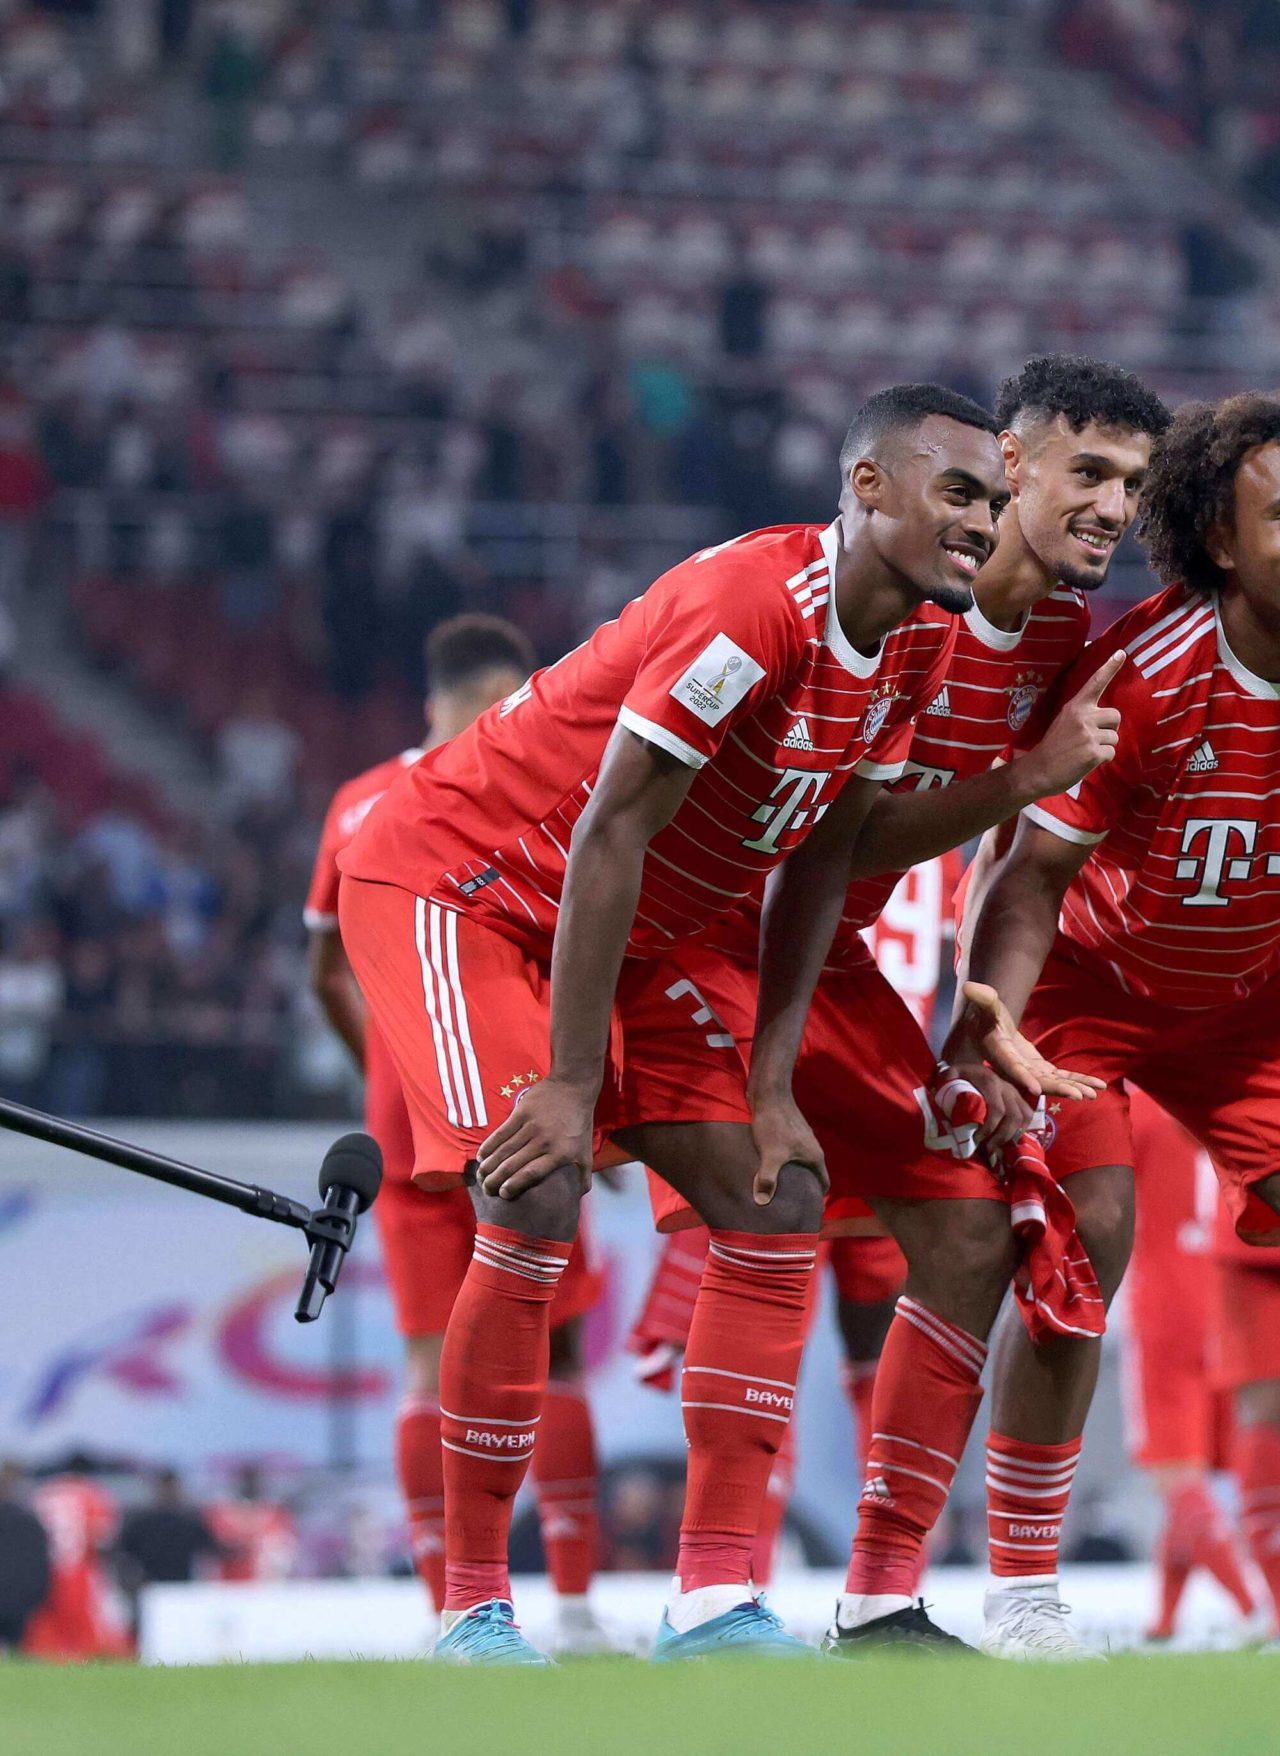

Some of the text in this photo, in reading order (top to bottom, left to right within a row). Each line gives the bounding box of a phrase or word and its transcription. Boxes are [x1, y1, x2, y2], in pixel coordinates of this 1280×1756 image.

[686, 682, 720, 710] SUPERCUP
[689, 695, 707, 711] 2022
[926, 704, 952, 717] adidas
[783, 735, 814, 752] adidas
[465, 1429, 536, 1449] BAYERN
